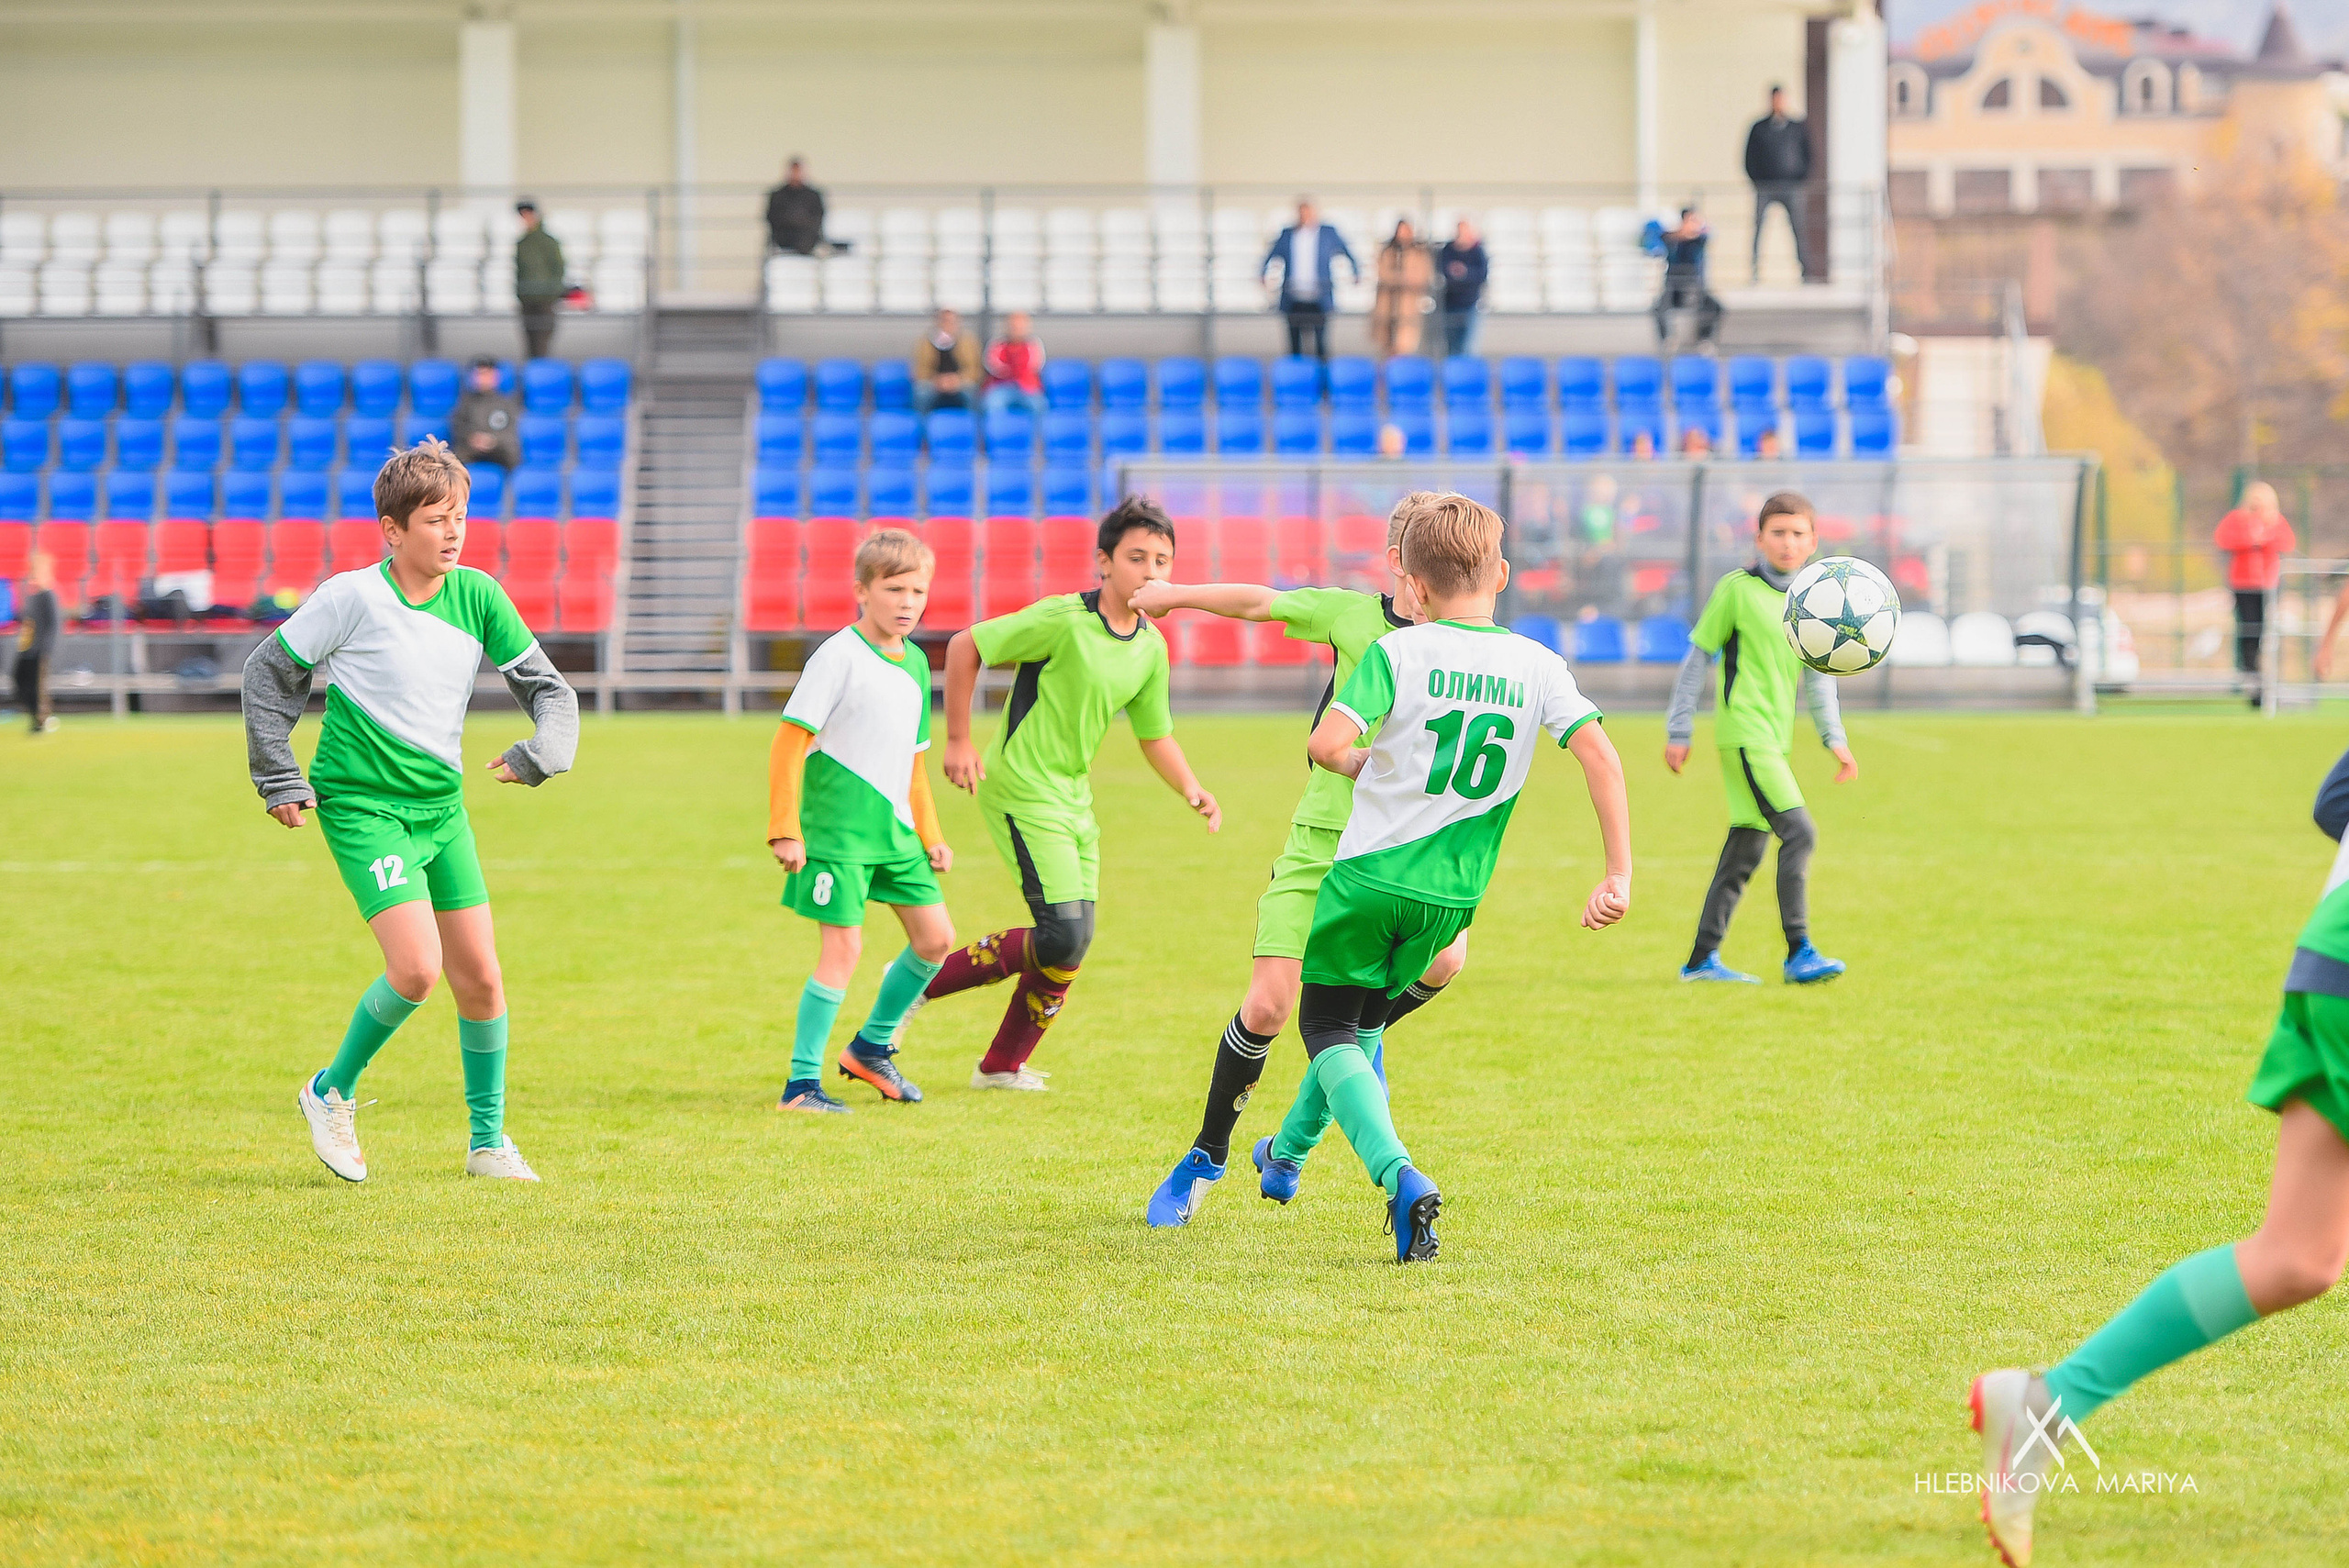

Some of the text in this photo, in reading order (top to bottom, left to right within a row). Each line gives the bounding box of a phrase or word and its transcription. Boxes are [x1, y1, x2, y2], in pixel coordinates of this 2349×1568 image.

[1428, 668, 1524, 708] ОЛИМП
[1424, 709, 1515, 800] 16
[368, 854, 408, 892] 12
[812, 871, 834, 906] 8
